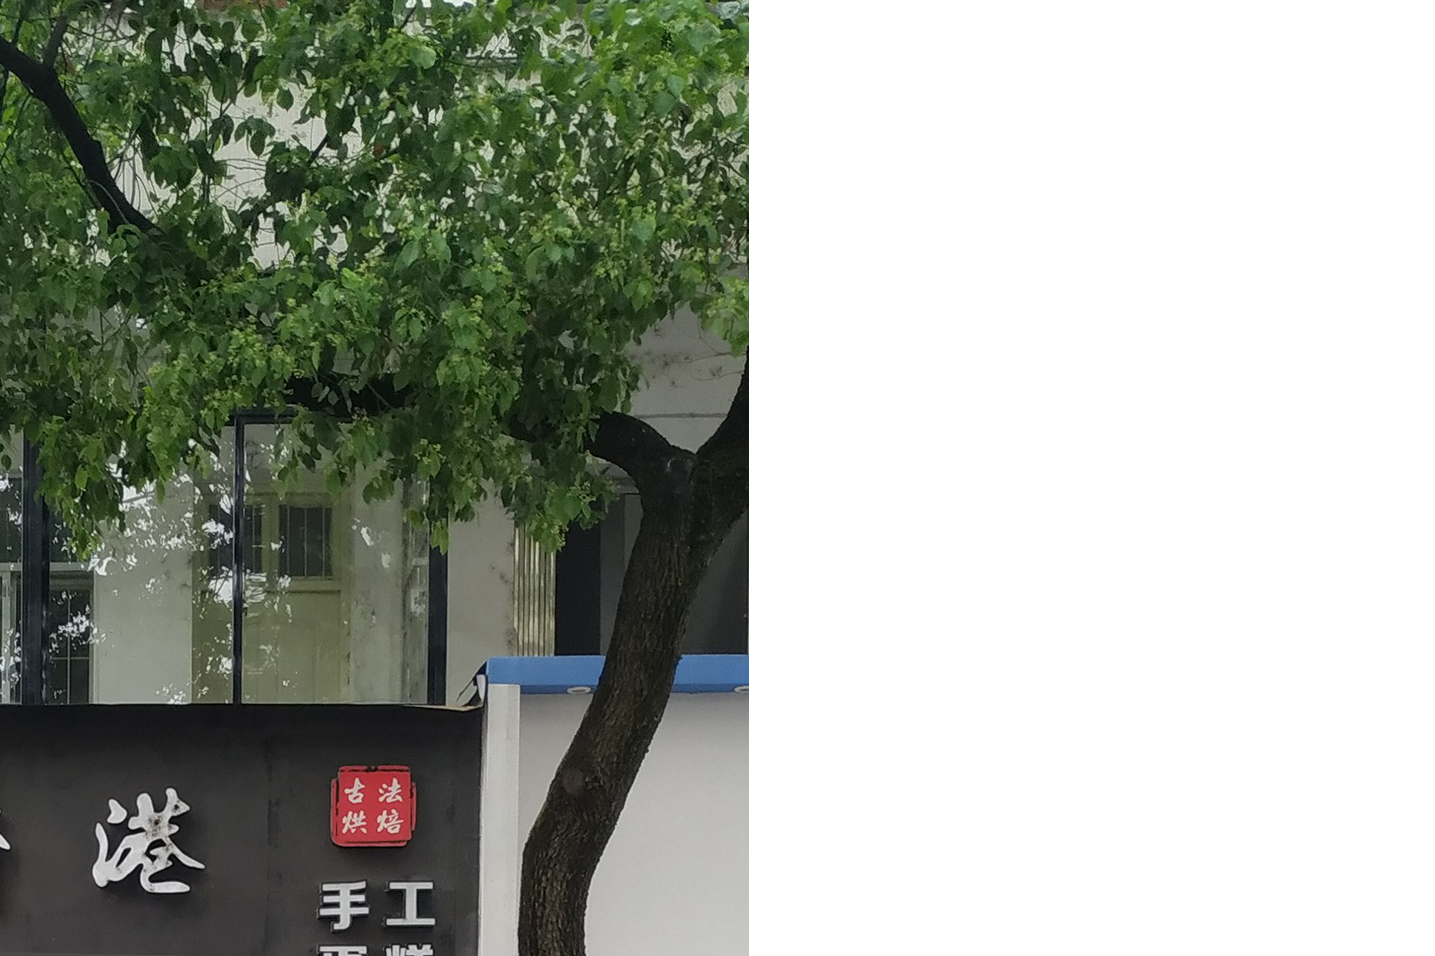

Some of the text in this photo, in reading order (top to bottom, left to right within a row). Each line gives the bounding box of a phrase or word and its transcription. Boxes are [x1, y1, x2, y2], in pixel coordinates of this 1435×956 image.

[344, 777, 403, 804] 古法
[342, 808, 404, 834] 烘焙
[318, 880, 436, 930] 手工
